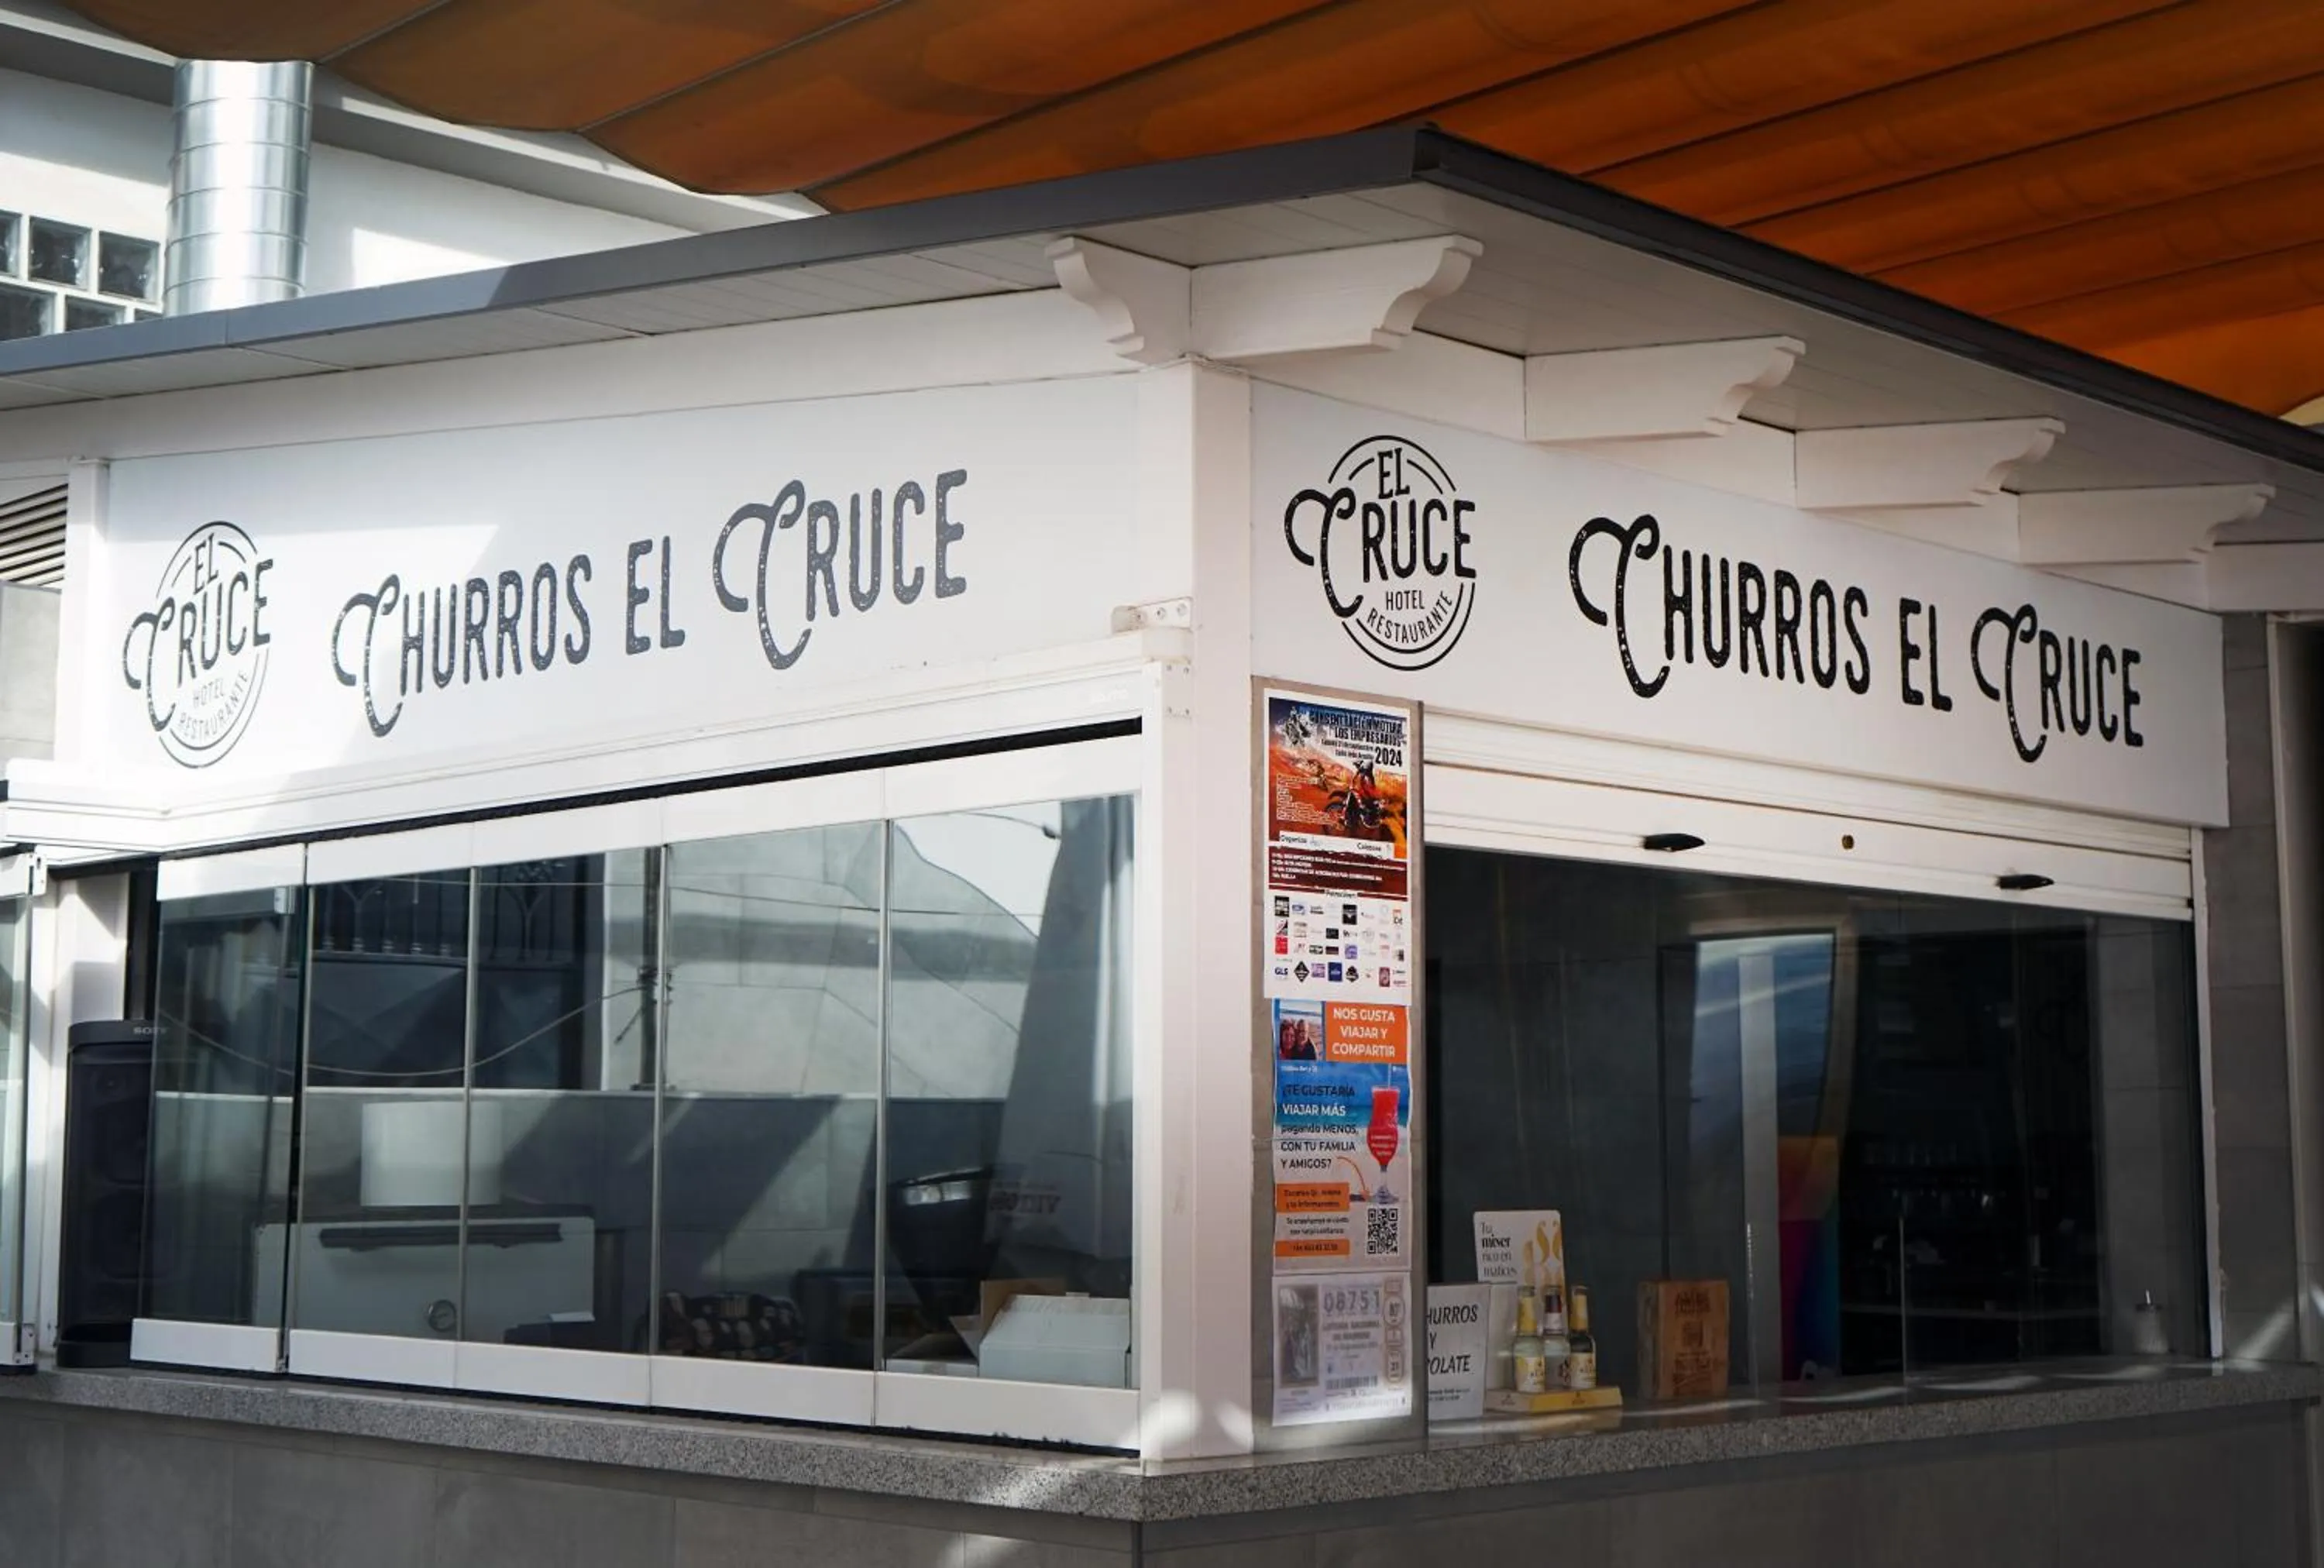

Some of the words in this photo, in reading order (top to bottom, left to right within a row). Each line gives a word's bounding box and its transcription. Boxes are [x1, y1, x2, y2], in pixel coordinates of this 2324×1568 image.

[1377, 447, 1410, 500] EL
[1284, 487, 1477, 618] CRUCE
[193, 532, 218, 595] EL
[332, 554, 592, 737] CHURROS
[626, 535, 686, 655] EL
[713, 469, 968, 670] CRUCE
[1385, 590, 1425, 610] HOTEL
[1367, 590, 1453, 644] RESTAURANTE
[122, 558, 273, 732] CRUCE
[1569, 514, 1871, 698] CHURROS
[1899, 597, 1952, 712] EL
[1970, 603, 2144, 763] CRUCE
[193, 677, 225, 708] HOTEL
[179, 669, 249, 743] RESTAURANTE
[1375, 747, 1402, 767] 2024
[1333, 1008, 1357, 1020] NOS
[1360, 1009, 1395, 1023] GUSTA
[1339, 1026, 1378, 1039] VIAJAR
[1380, 1027, 1388, 1039] Y
[1332, 1043, 1395, 1057] COMPARTIR
[1282, 1103, 1318, 1116] VIAJAR
[1321, 1103, 1346, 1116] MÁS
[1281, 1123, 1321, 1135] pagando
[1281, 1141, 1304, 1152] CON
[1305, 1141, 1316, 1151] TU
[1319, 1141, 1356, 1151] FAMILIA
[1281, 1158, 1288, 1169] Y
[1289, 1157, 1332, 1169] AMIGOS?
[1429, 1332, 1437, 1350] Y
